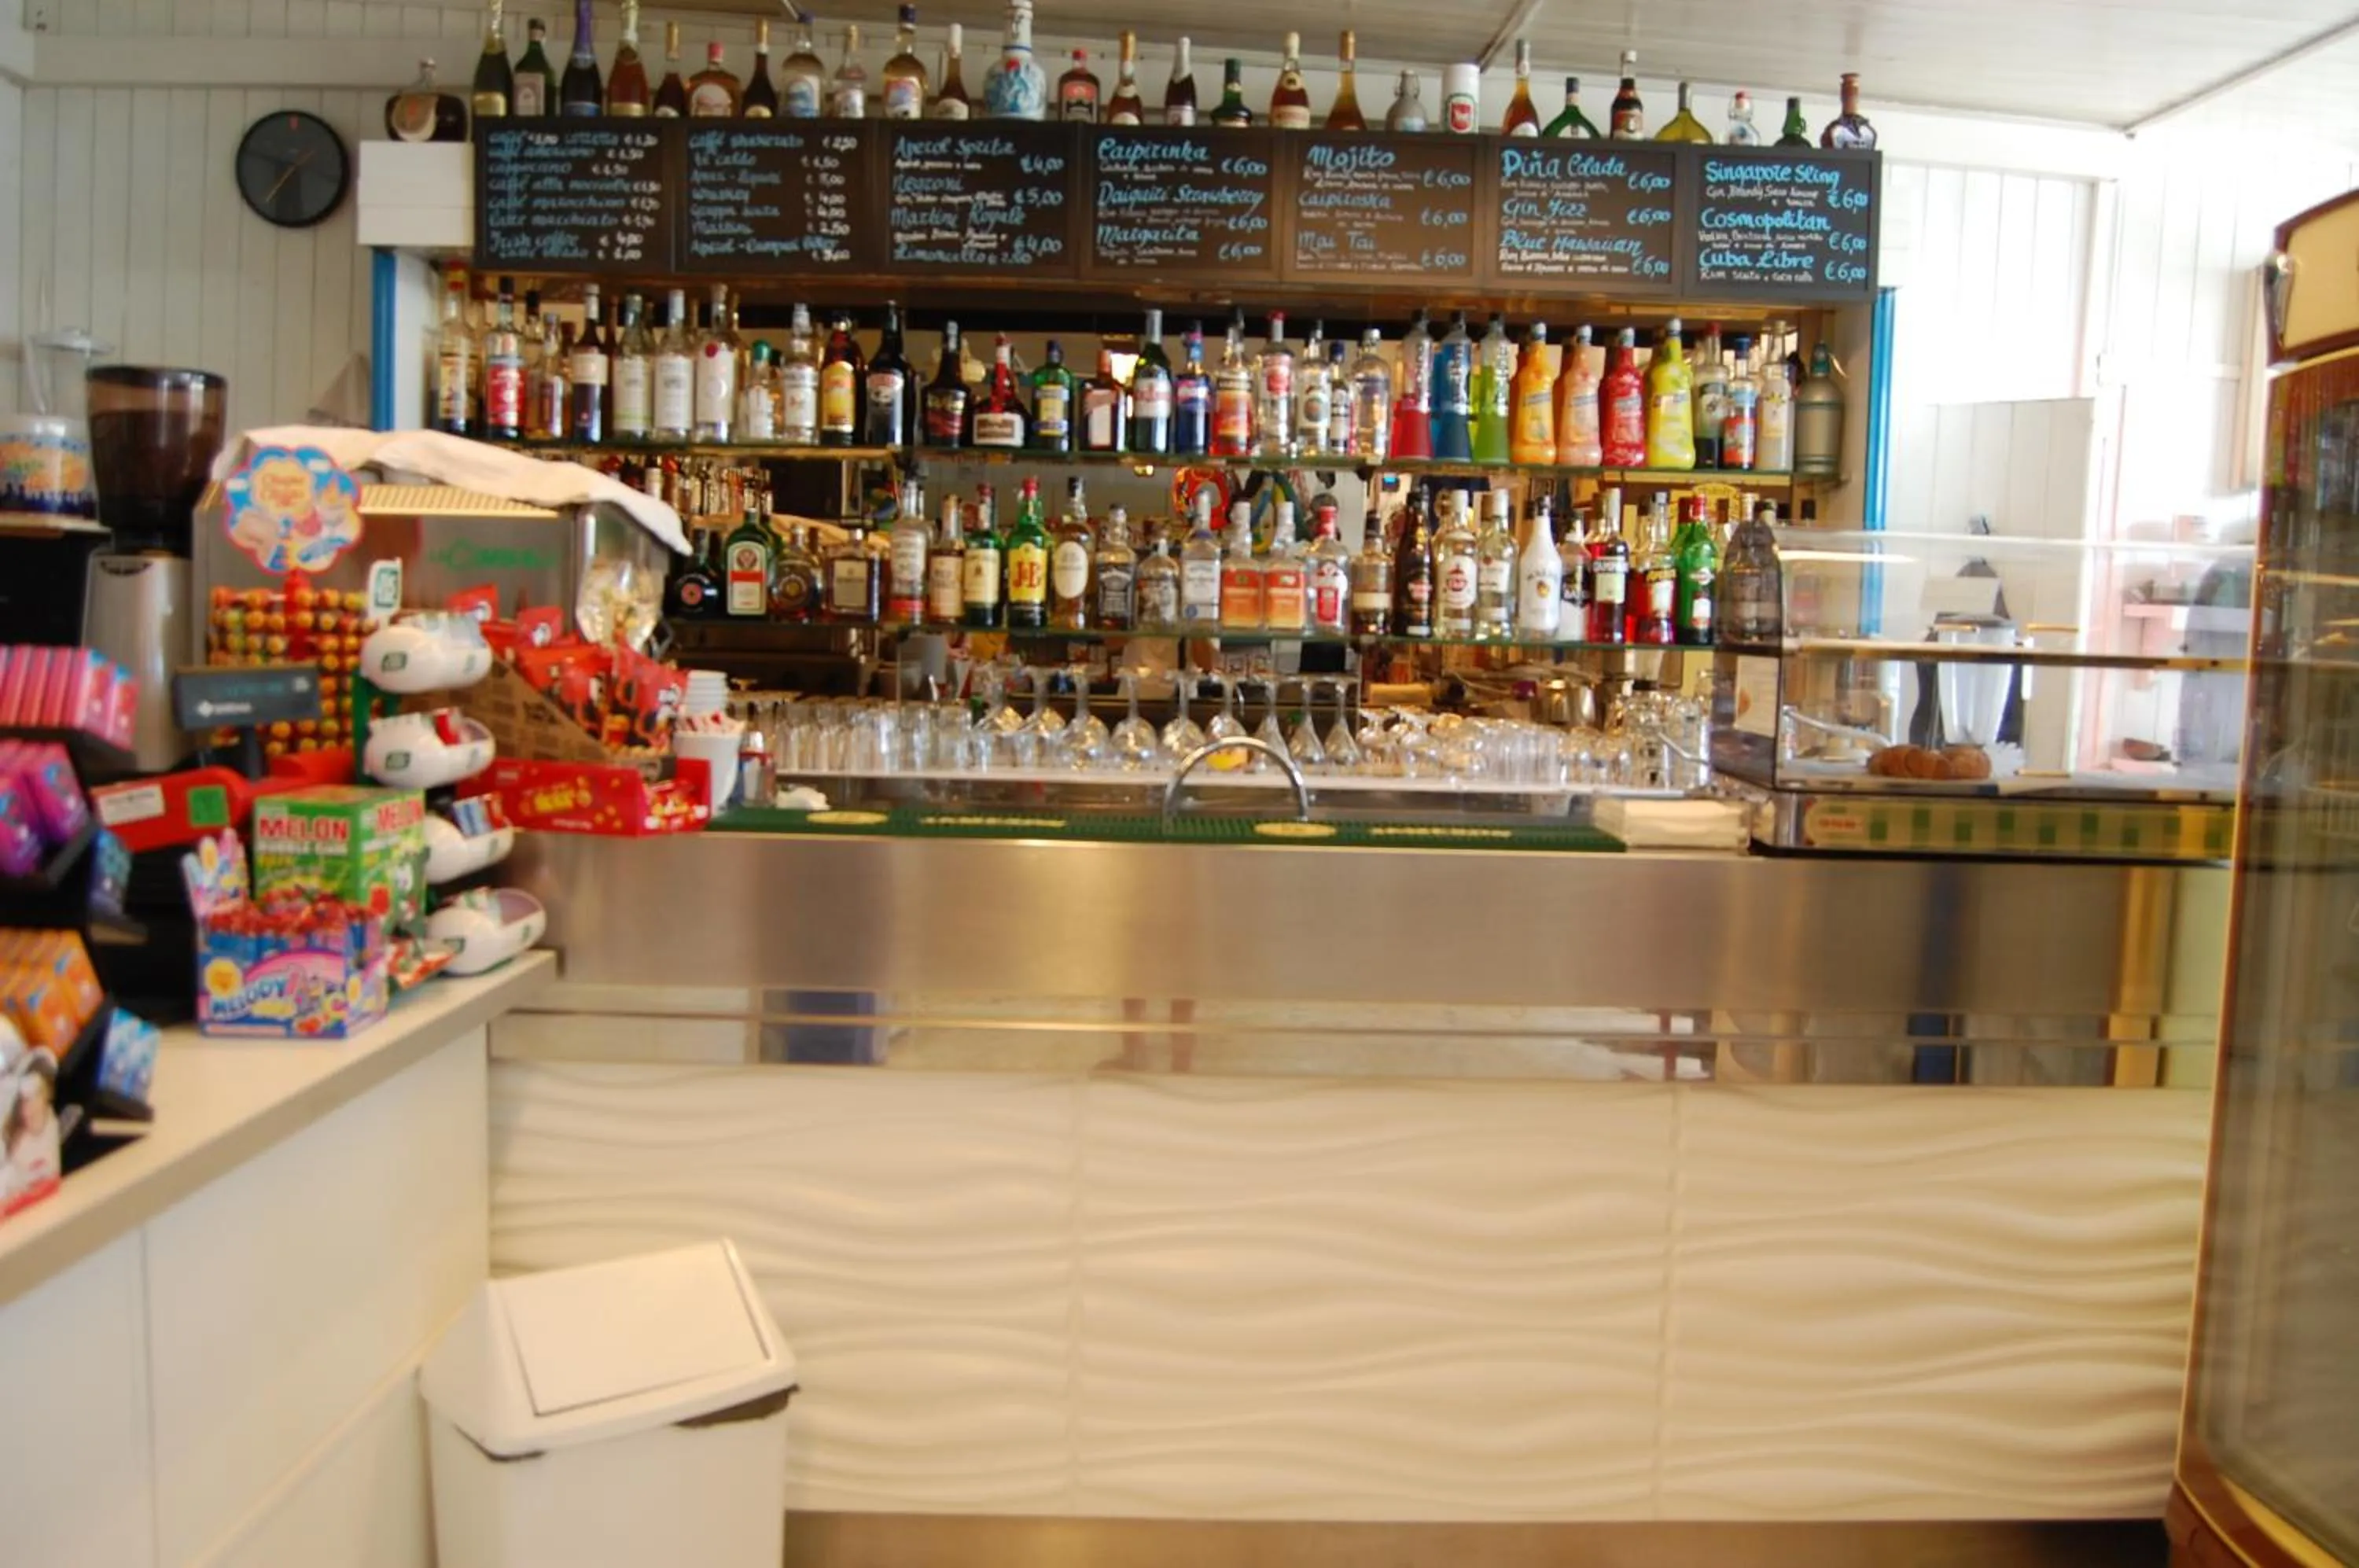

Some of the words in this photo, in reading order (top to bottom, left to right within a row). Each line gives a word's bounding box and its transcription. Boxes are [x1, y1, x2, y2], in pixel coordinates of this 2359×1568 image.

[1306, 145, 1397, 174] Mojito
[1500, 148, 1562, 179] Piña
[1566, 153, 1628, 178] Colada
[1704, 160, 1793, 189] Singapore
[1794, 164, 1841, 190] Sling
[1501, 197, 1543, 220] Gin
[1700, 207, 1832, 237] Cosmopolitan
[1698, 248, 1753, 268] Cuba
[1755, 250, 1815, 270] Libre
[259, 816, 349, 841] MELON
